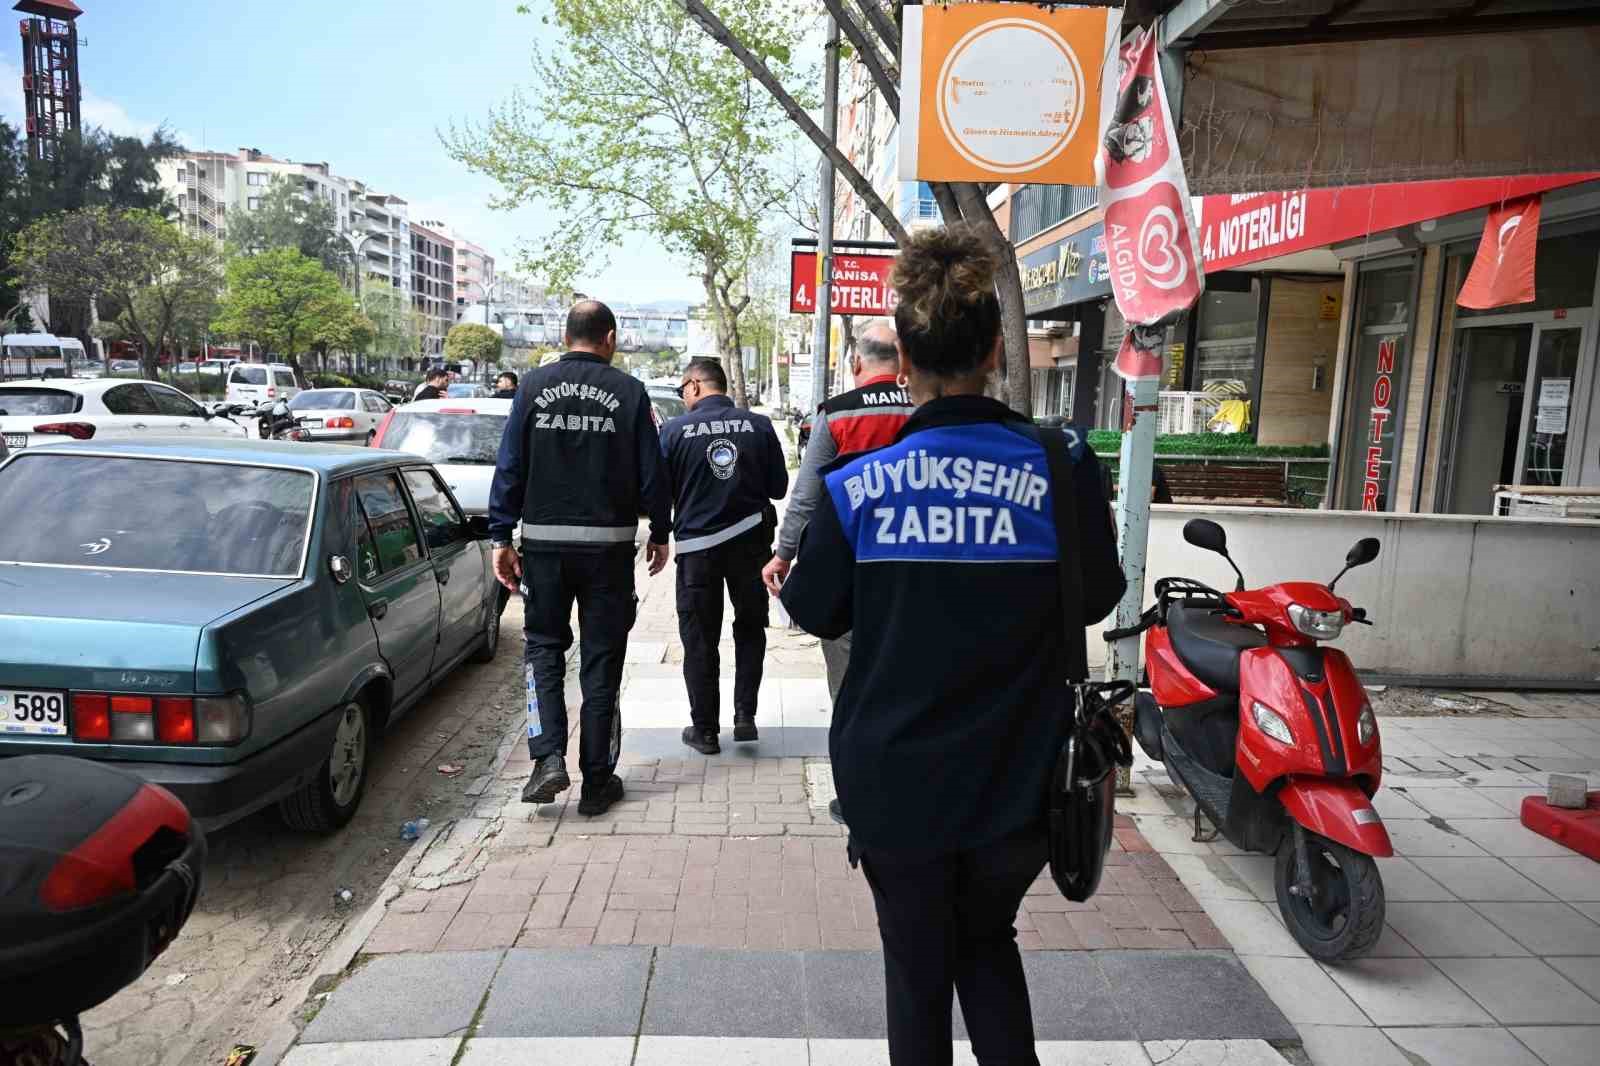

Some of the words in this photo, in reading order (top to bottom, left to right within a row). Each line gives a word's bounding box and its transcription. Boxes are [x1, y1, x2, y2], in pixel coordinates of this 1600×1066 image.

[1203, 224, 1216, 262] 4.
[832, 270, 879, 282] ANİSA
[842, 260, 861, 269] T.C.
[795, 284, 811, 307] 4.
[534, 381, 620, 412] BÜYÜKŞEHİR
[862, 388, 913, 406] MANİ
[535, 412, 616, 433] ZABITA
[1362, 339, 1396, 513] NOTER
[844, 449, 1049, 512] BÜYÜKŞEHİR
[874, 505, 1018, 545] ZABITA
[14, 694, 61, 723] 589
